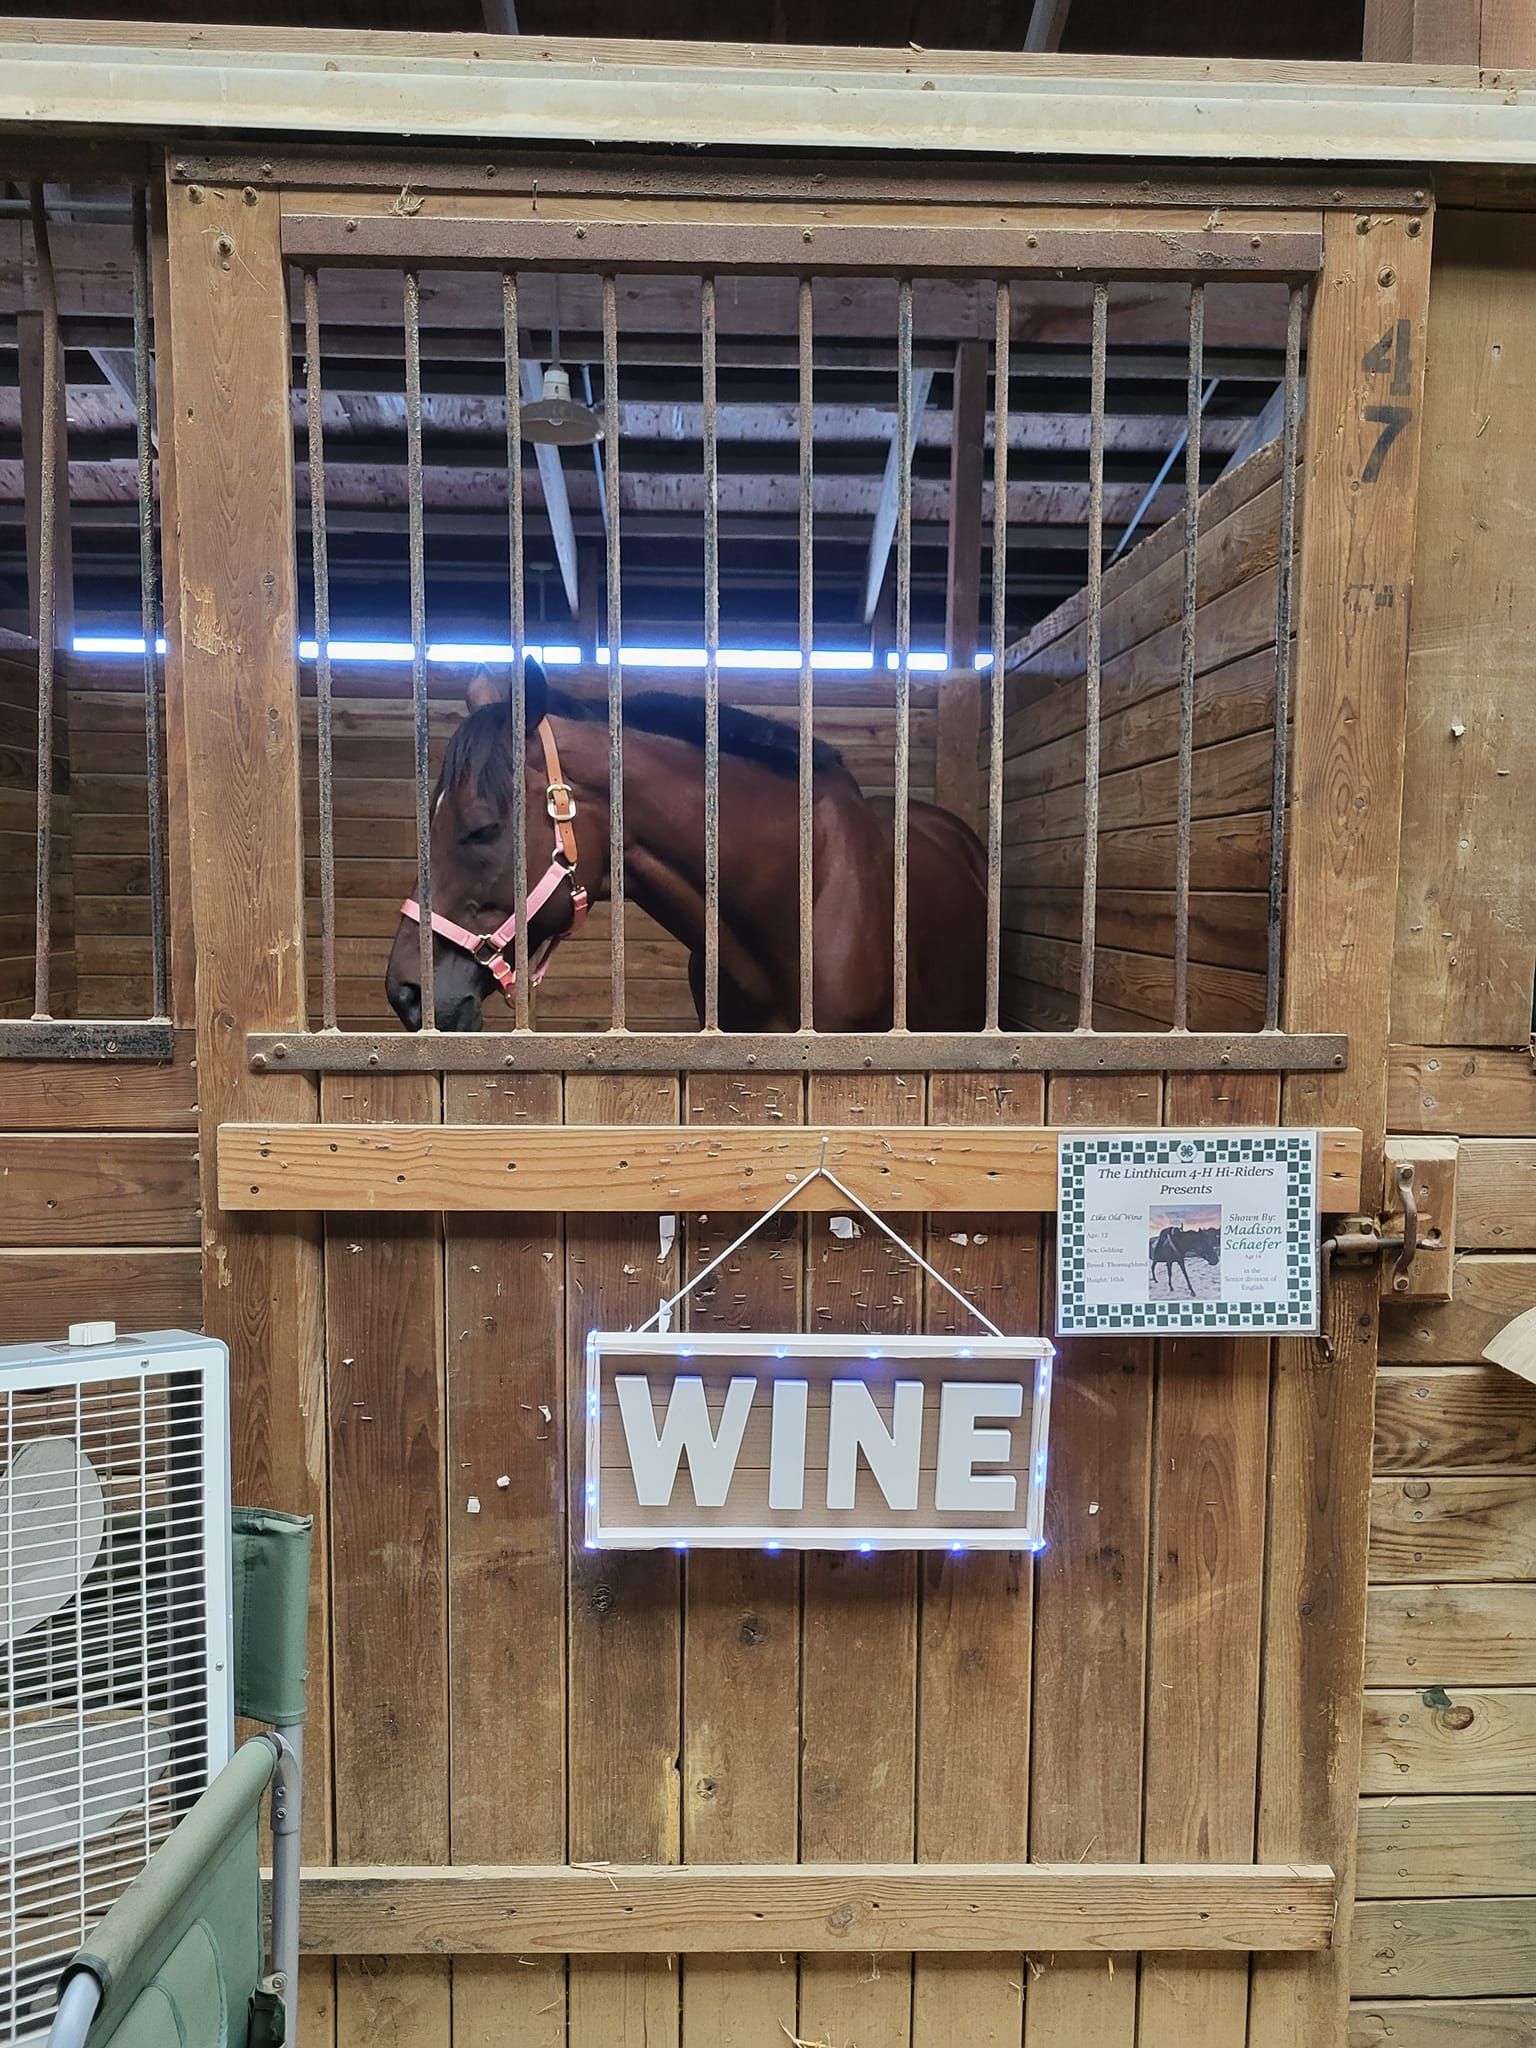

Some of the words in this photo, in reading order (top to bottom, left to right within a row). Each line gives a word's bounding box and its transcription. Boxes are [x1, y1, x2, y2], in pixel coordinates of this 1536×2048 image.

[1097, 1168, 1121, 1179] The
[1124, 1167, 1186, 1179] Linthicum
[1189, 1167, 1212, 1180] 4-H
[1215, 1166, 1274, 1178] Hi-Riders
[1160, 1184, 1213, 1195] Presents
[1229, 1213, 1259, 1222] Shown
[1261, 1213, 1276, 1224] By:
[1224, 1222, 1282, 1235] Madison
[1224, 1237, 1283, 1253] Schaefer
[614, 1373, 1024, 1511] WINE
